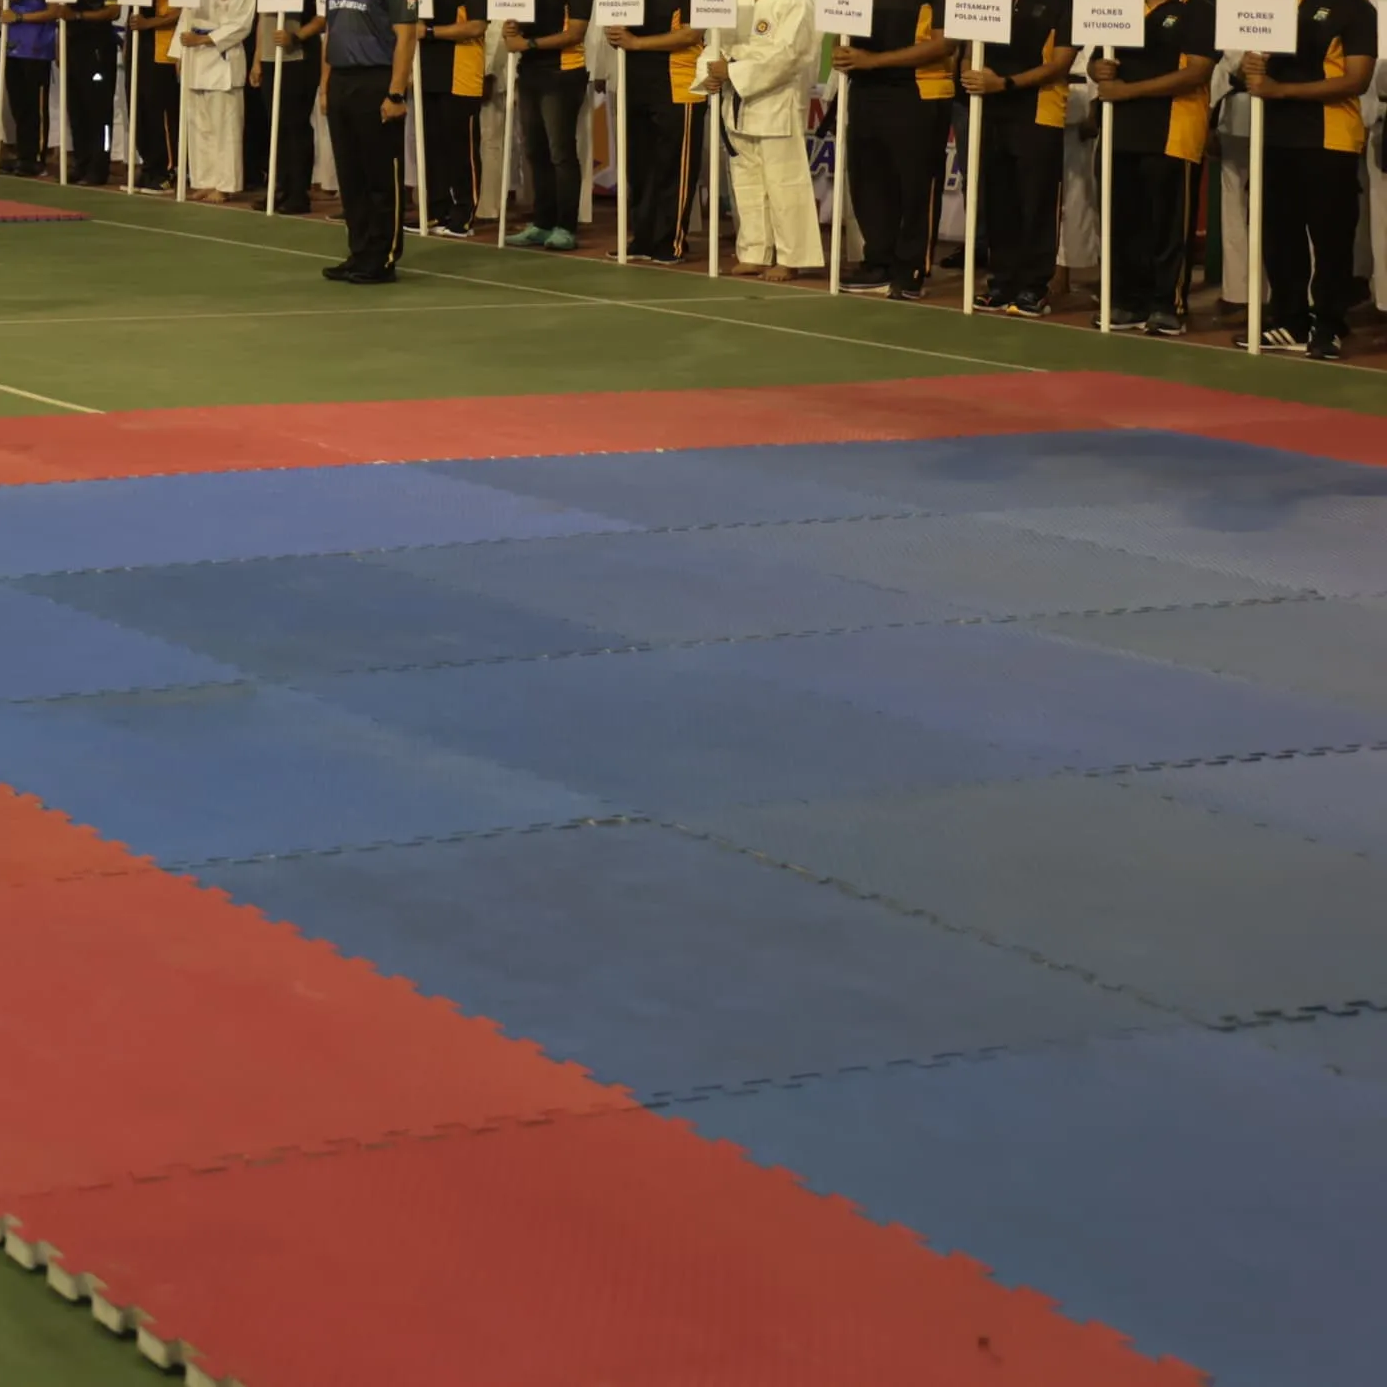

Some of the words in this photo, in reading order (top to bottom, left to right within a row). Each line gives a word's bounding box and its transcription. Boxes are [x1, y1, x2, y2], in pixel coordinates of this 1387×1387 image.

[1091, 8, 1123, 16] POLRES
[1237, 11, 1274, 20] POLRES
[1083, 21, 1132, 30] SITUBONDO
[1239, 25, 1272, 34] KEDIRI
